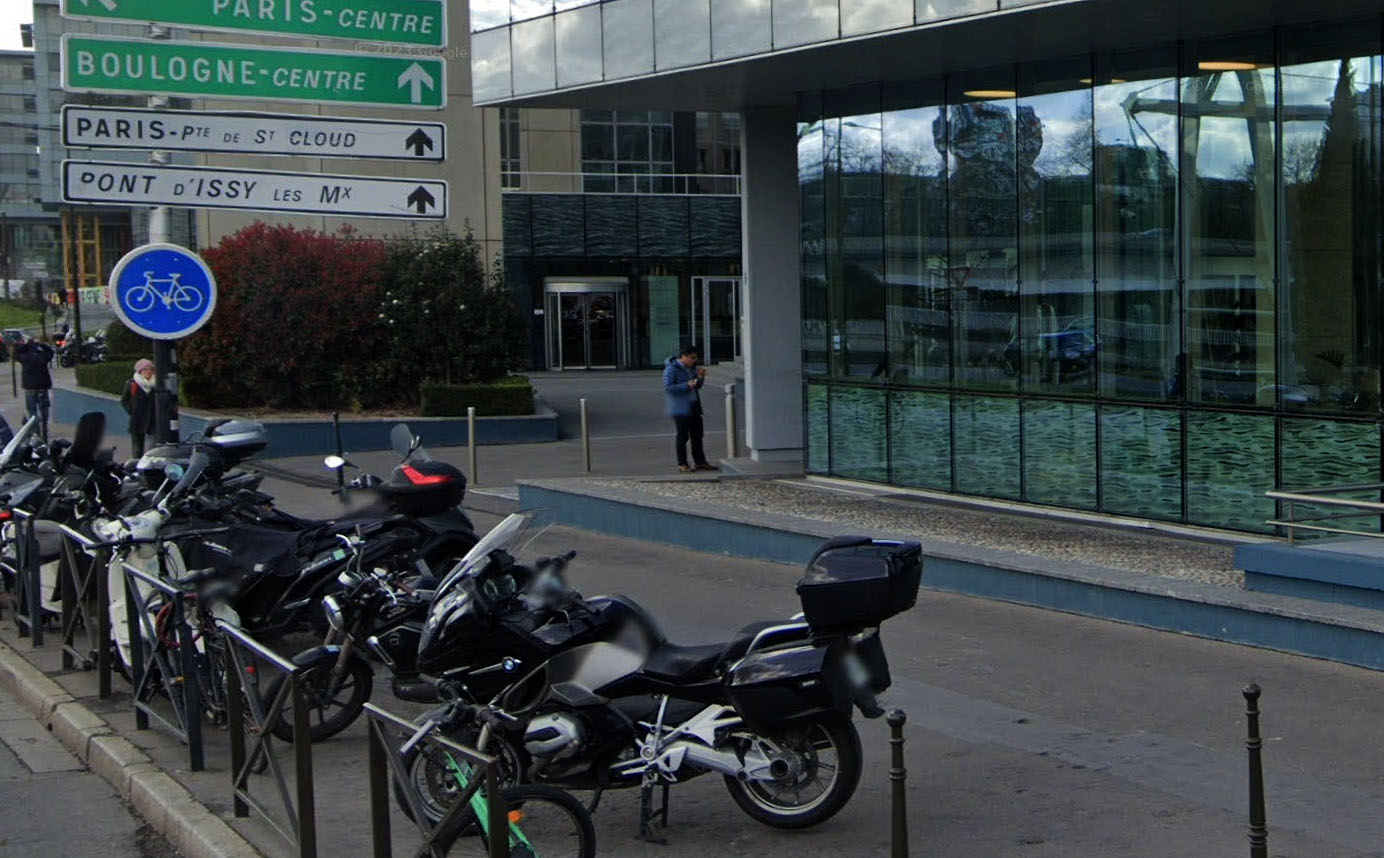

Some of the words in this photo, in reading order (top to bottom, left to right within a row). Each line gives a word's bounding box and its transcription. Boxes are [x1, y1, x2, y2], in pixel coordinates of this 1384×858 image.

[77, 51, 366, 91] BOULOGNE-CENTRE
[223, 133, 240, 144] DE
[289, 130, 356, 148] CLOUD
[274, 188, 303, 202] LES
